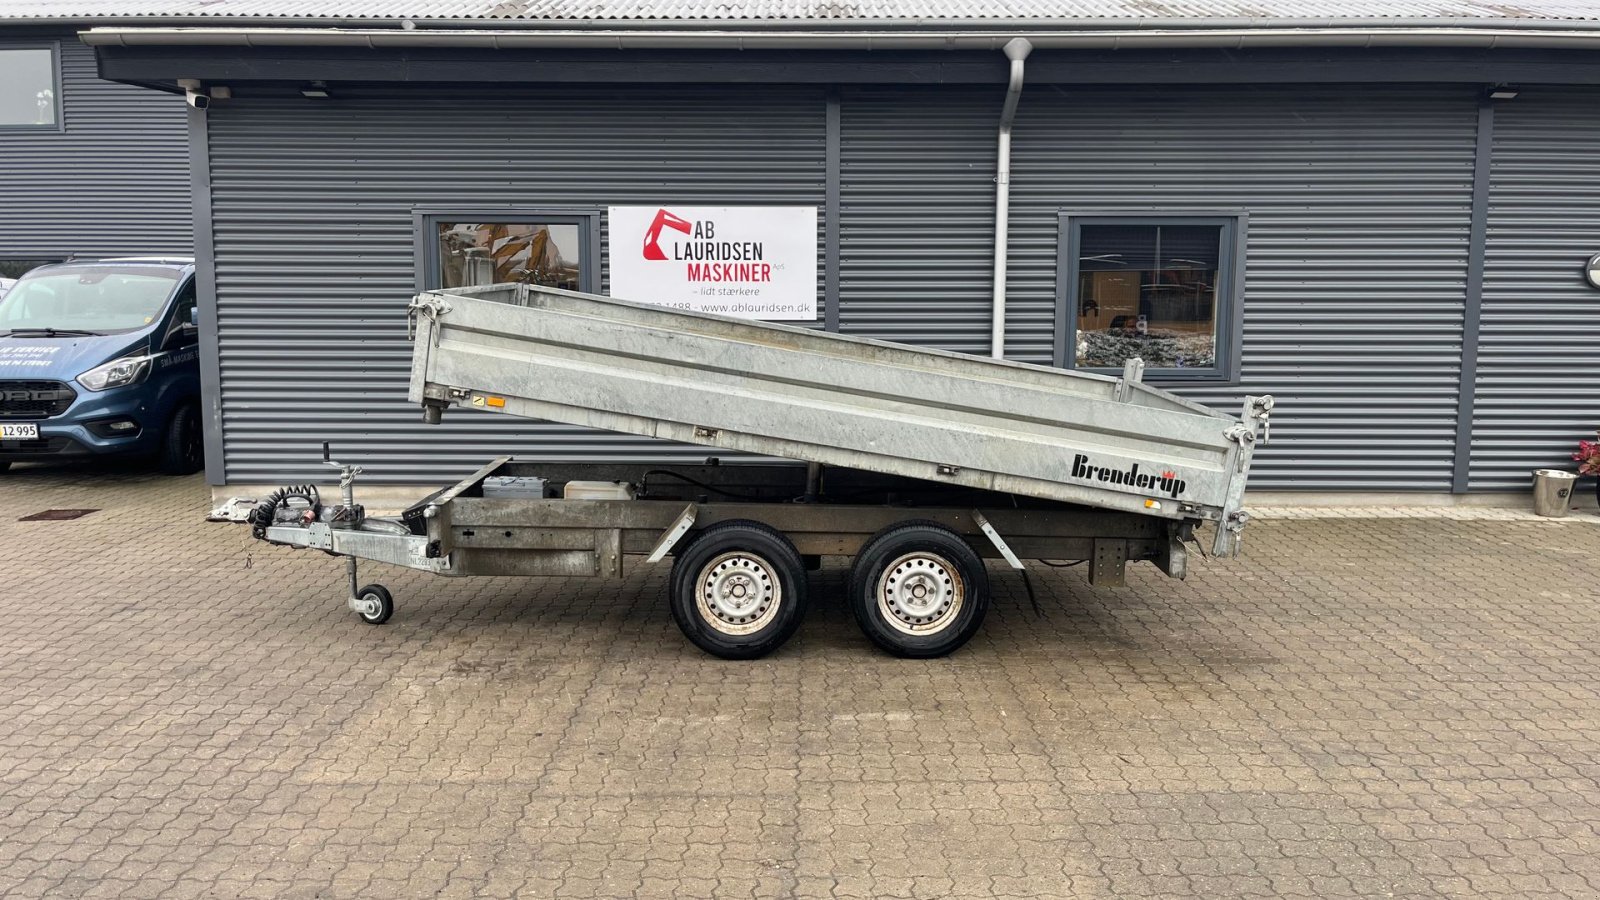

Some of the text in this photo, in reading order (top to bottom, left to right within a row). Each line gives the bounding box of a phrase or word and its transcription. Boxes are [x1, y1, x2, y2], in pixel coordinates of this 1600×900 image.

[694, 220, 715, 239] AB
[674, 242, 762, 260] LAURIDSEN
[688, 263, 771, 282] MASKINER
[700, 287, 716, 296] lidt
[718, 287, 760, 296] stærkere
[701, 302, 811, 313] www.ablauridsen.dk
[3, 426, 36, 436] 12 995
[1071, 453, 1186, 498] Brenderup
